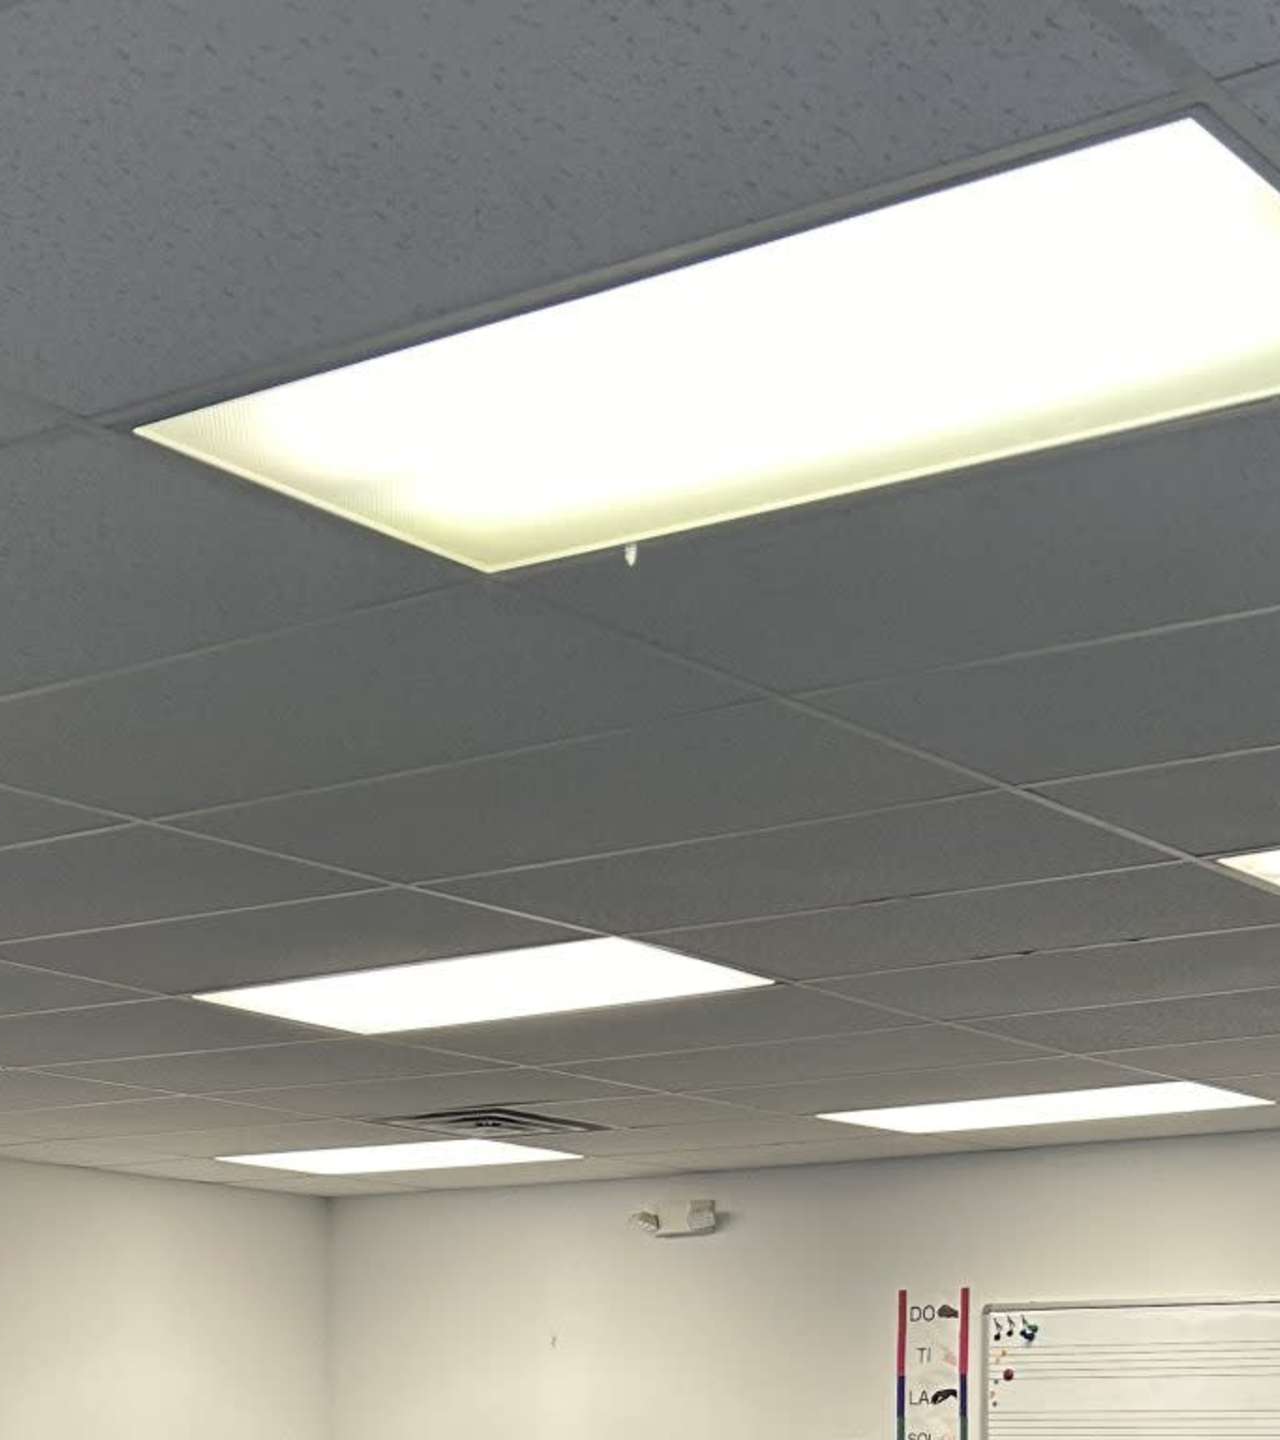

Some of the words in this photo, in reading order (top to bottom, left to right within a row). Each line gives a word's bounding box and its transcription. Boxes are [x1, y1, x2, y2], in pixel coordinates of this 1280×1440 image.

[909, 1304, 936, 1322] DO
[917, 1347, 932, 1364] TI
[909, 1389, 931, 1406] LA
